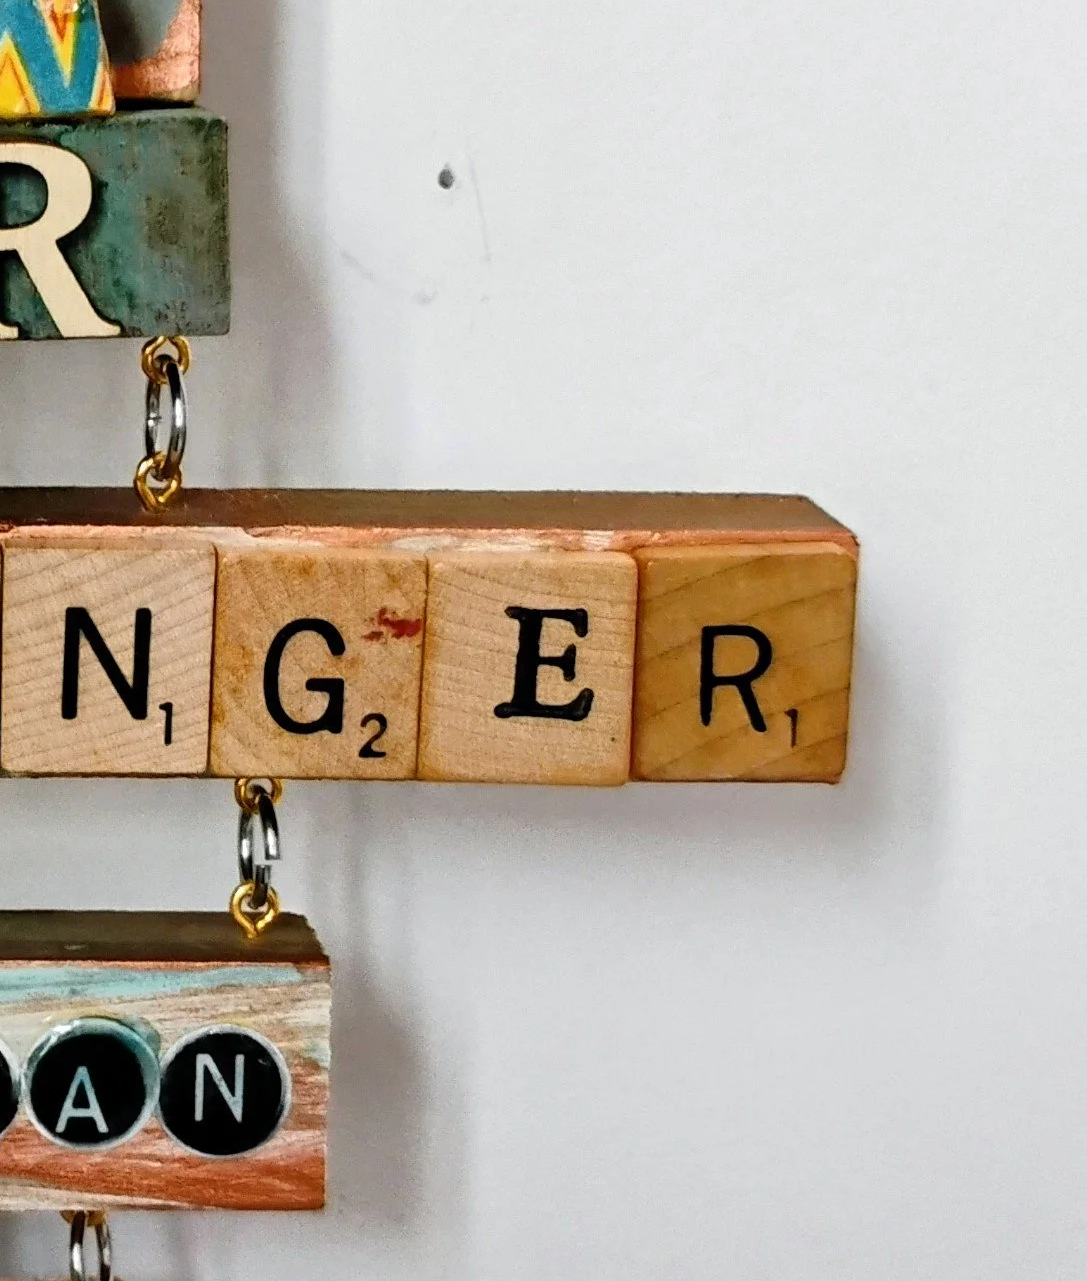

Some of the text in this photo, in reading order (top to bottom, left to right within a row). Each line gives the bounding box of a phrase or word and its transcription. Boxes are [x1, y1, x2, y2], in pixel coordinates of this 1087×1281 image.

[157, 701, 174, 747] 1
[357, 712, 388, 759] 2
[782, 708, 799, 748] 1
